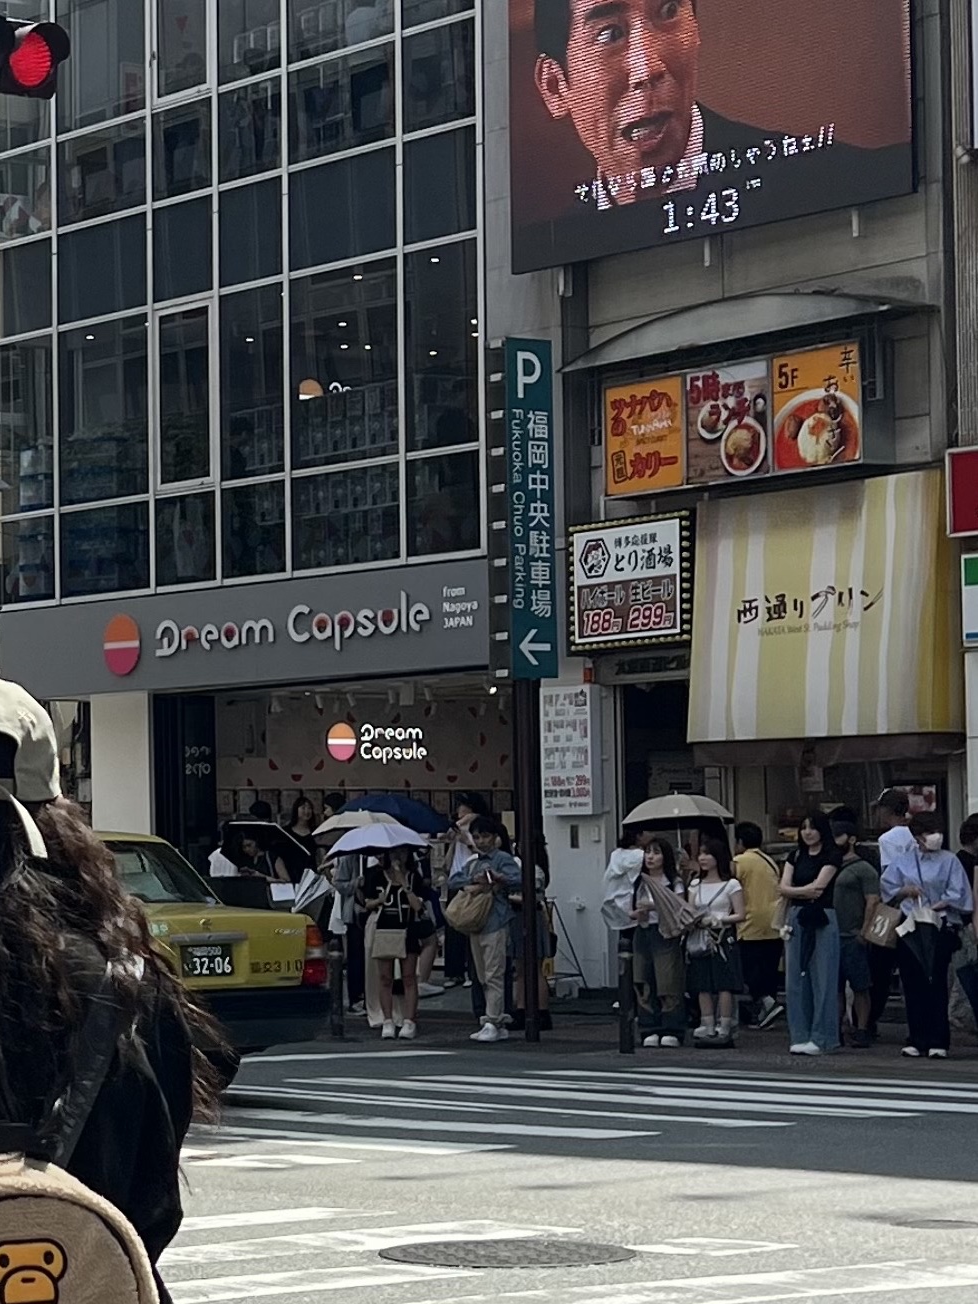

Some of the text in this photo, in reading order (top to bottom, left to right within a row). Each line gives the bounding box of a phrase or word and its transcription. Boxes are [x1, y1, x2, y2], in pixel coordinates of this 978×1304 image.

[663, 187, 740, 234] 1:43
[516, 350, 542, 399] P
[777, 362, 798, 389] 5F
[511, 408, 527, 610] Fukuoka Chuo Parking
[527, 410, 552, 618] 福岡中央駐車場
[613, 543, 675, 573] とり酒場
[442, 585, 466, 599] from
[628, 577, 675, 604] 生ビール
[442, 599, 479, 614] Nagoya
[155, 589, 431, 657] Dream Capsule
[443, 615, 474, 630] JAPAN
[360, 723, 423, 741] Dream
[360, 741, 428, 765] Capsule
[192, 956, 233, 976] 32-06
